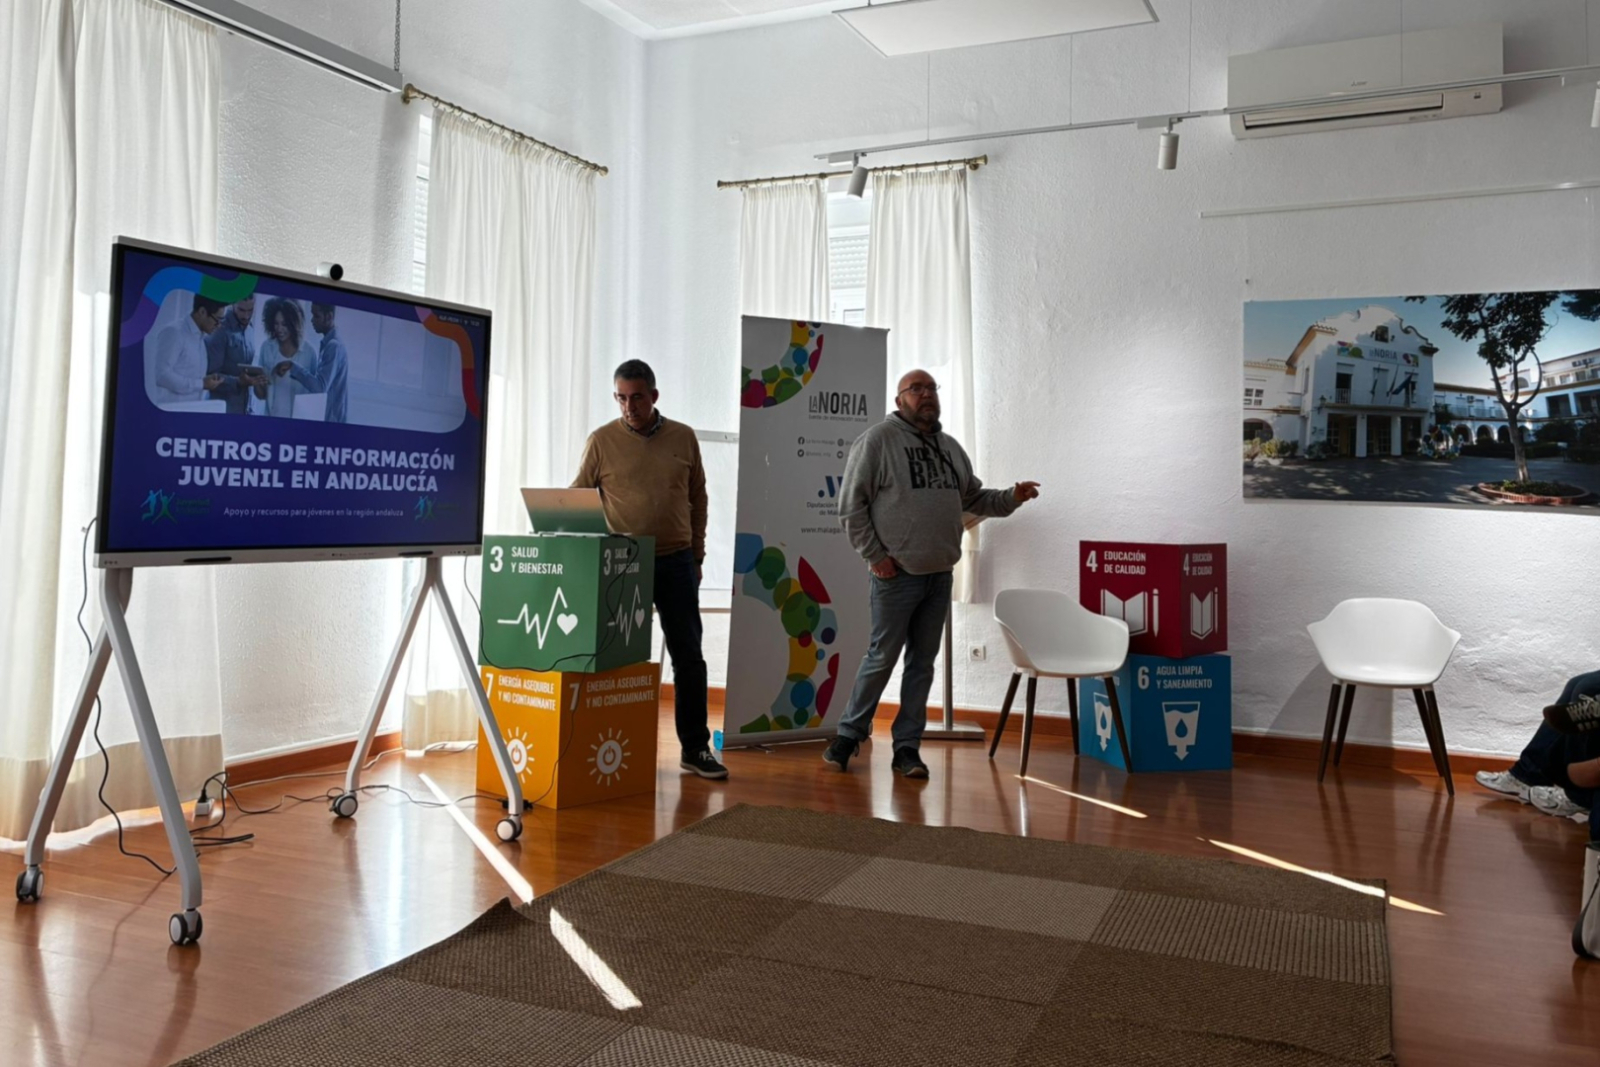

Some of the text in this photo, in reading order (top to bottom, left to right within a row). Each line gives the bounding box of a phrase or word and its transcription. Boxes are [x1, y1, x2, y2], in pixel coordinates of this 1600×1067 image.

[1374, 348, 1398, 360] NORIA
[809, 391, 868, 416] LA NORIA
[155, 436, 455, 471] CENTROS DE INFORMACIÓN
[178, 465, 438, 492] JUVENIL EN ANDALUCÍA
[224, 507, 248, 519] Apoyo
[250, 509, 257, 518] y
[257, 508, 288, 517] recursos
[290, 508, 306, 518] para
[307, 508, 334, 518] jóvenes
[346, 508, 352, 516] la
[354, 508, 374, 518] región
[376, 508, 404, 517] andaluza
[490, 546, 504, 573] 3
[511, 546, 539, 558] SALUD
[1086, 550, 1098, 572] 4
[1104, 550, 1146, 562] EDUCACIÓN
[511, 562, 564, 575] Y BIENESTAR
[604, 548, 612, 576] 3
[1104, 564, 1146, 575] DE CALIDAD
[1183, 553, 1190, 576] 4
[1137, 666, 1149, 690] 6
[1156, 665, 1203, 676] AGUA LIMPIA
[486, 673, 493, 699] 7
[498, 675, 554, 694] ENERGÍA ASEQUIBLE
[586, 674, 653, 692] ENERGÍA ASEQUIBLE
[1156, 678, 1212, 689] Y SANEAMIENTO
[498, 691, 556, 711] Y NO CONTAMINANTE
[569, 683, 580, 711] 7
[586, 690, 654, 708] Y NO CONTAMINANTE
